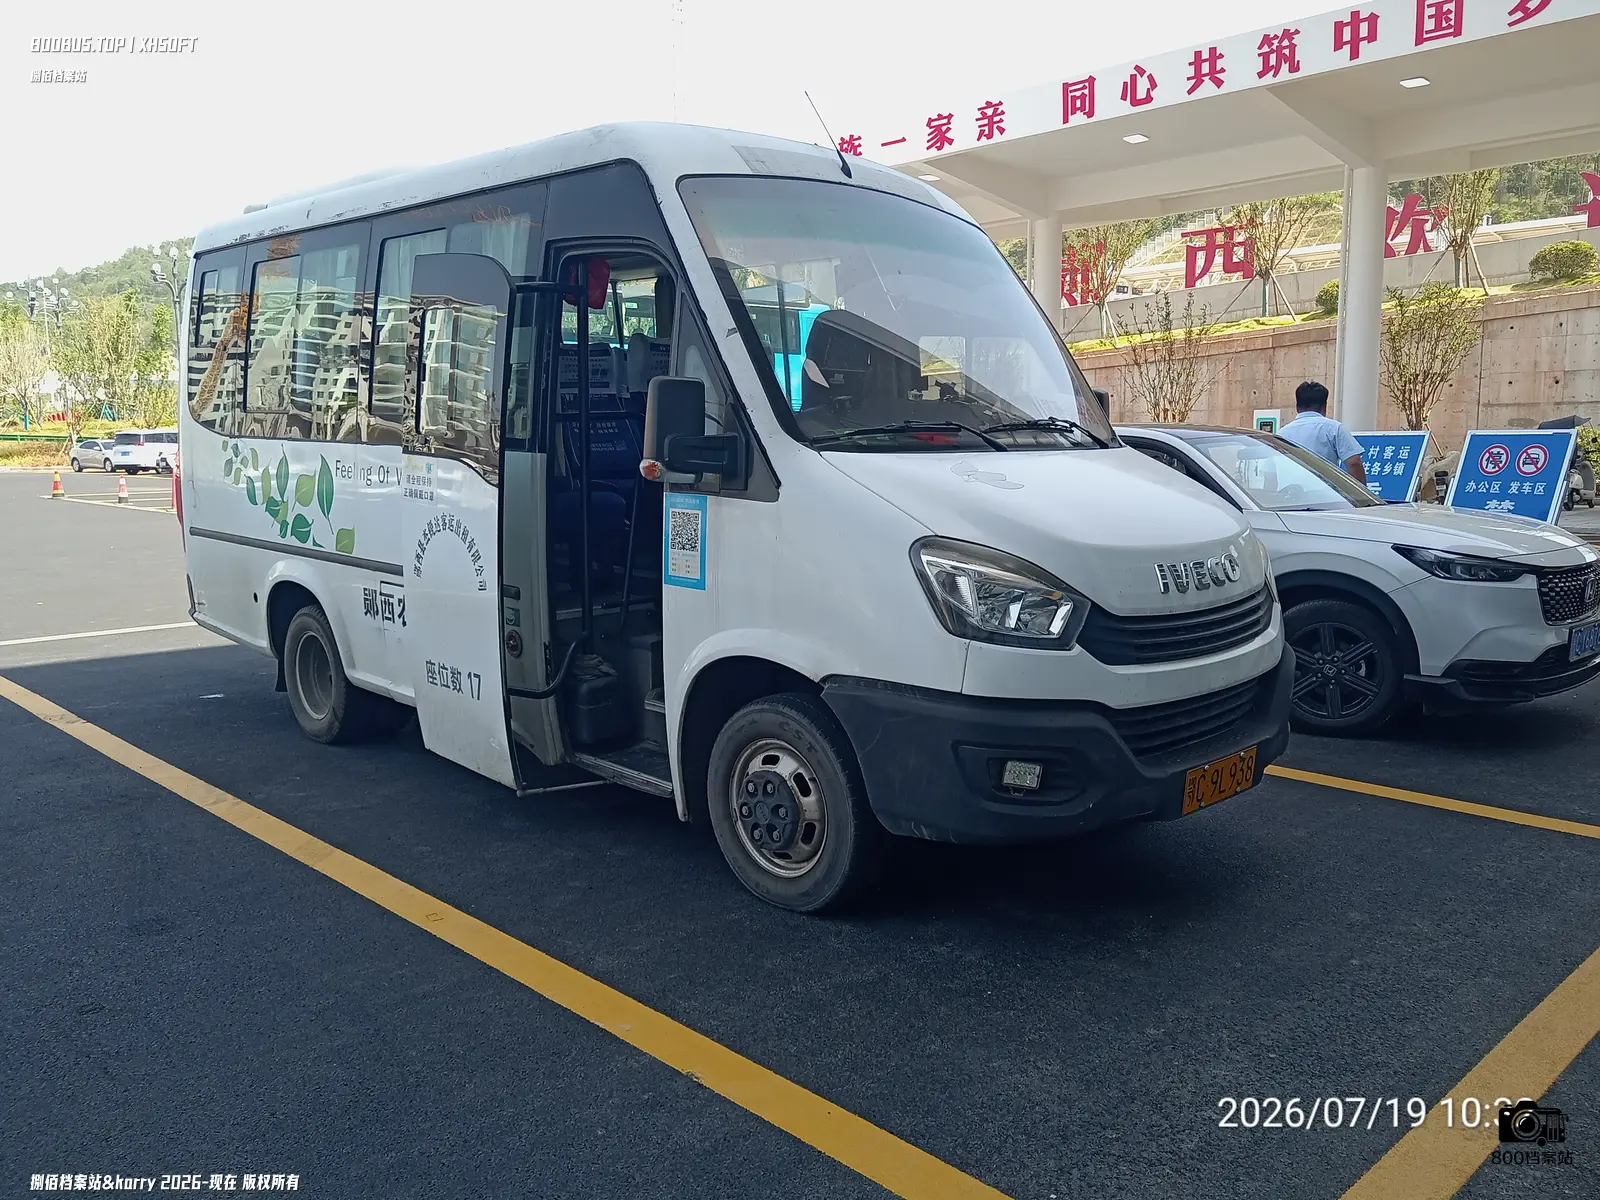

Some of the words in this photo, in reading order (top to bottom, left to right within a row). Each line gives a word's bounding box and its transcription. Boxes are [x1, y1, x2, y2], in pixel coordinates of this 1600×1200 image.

[1361, 445, 1411, 460] 村客运
[336, 459, 373, 486] Feeling
[378, 464, 390, 484] Of
[1465, 480, 1502, 494] 办公区
[1508, 481, 1547, 495] 发车区
[1154, 552, 1241, 594] IVECO
[426, 658, 464, 695] 座位数
[467, 671, 482, 701] 17
